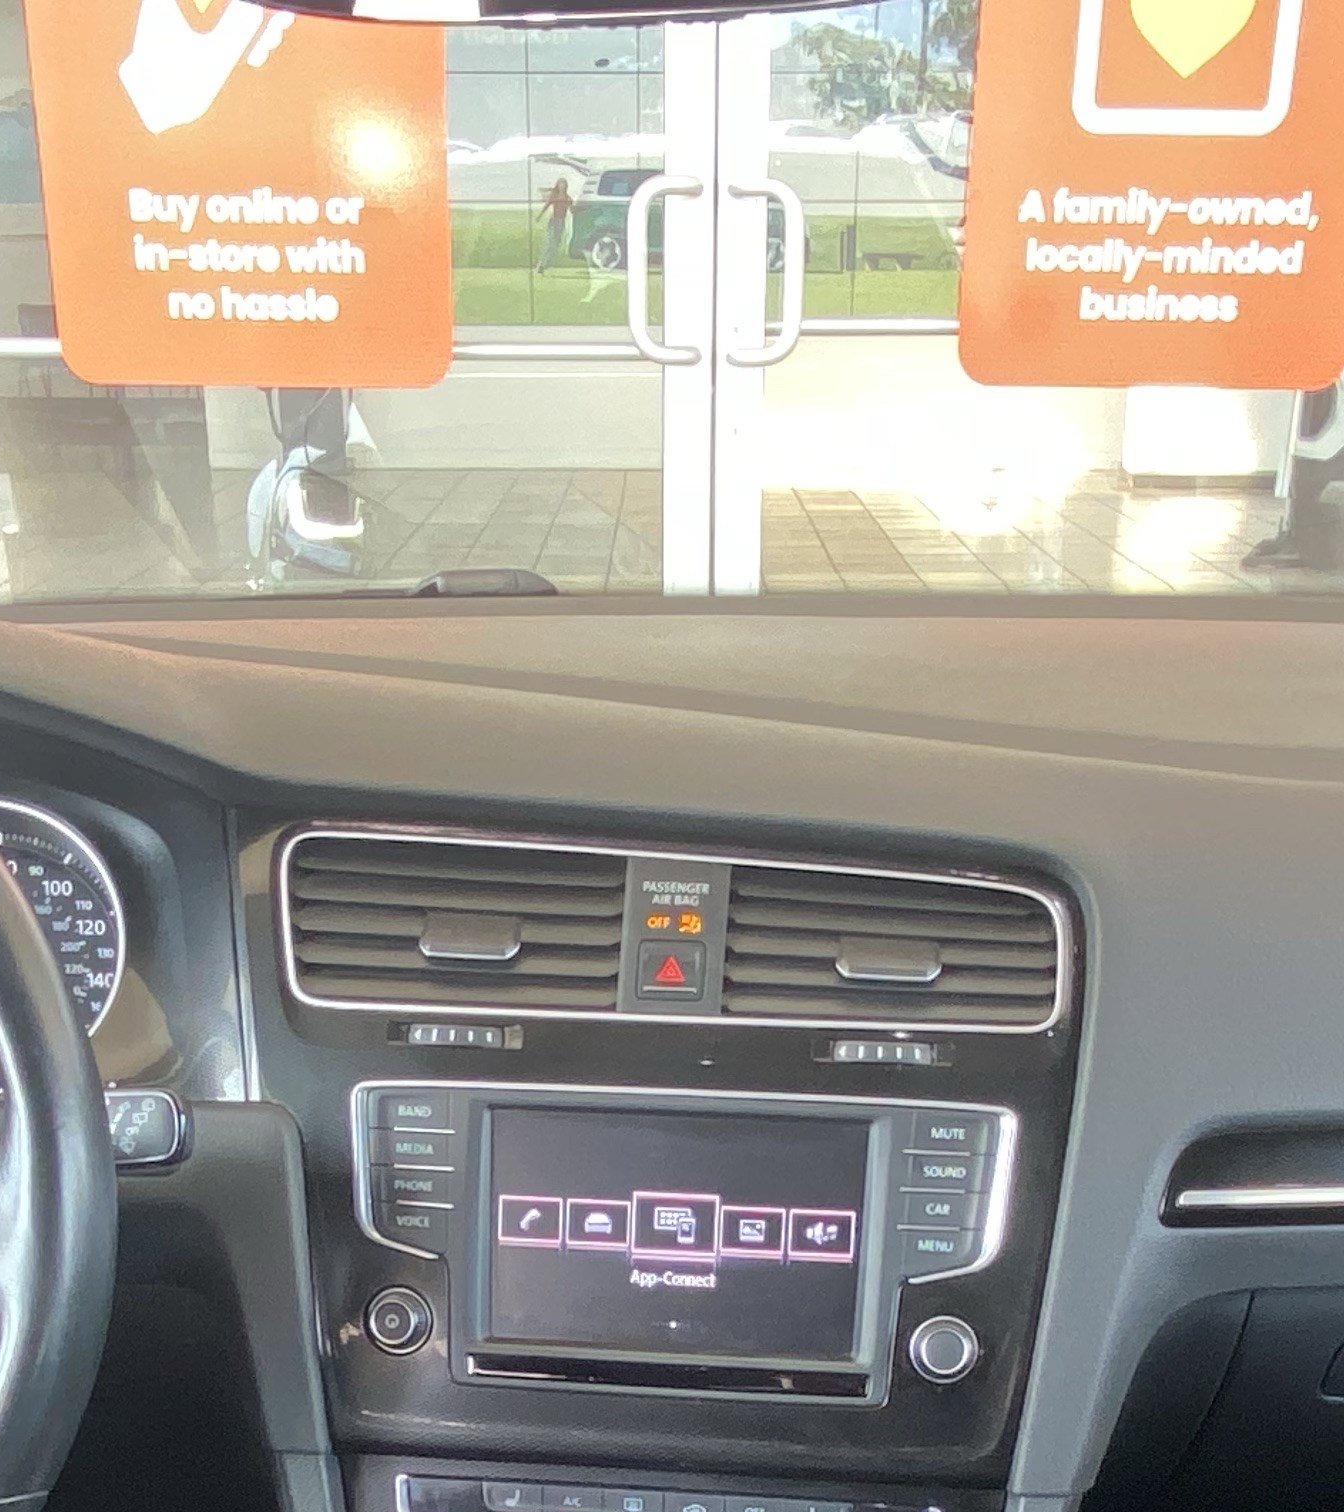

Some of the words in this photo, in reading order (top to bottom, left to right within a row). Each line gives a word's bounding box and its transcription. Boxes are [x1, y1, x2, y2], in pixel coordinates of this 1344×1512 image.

[129, 188, 197, 232] Buy
[206, 186, 318, 225] online
[324, 195, 365, 225] or
[1018, 189, 1045, 225] A
[1053, 187, 1320, 234] family-owned,
[134, 234, 279, 273] in-store
[284, 236, 366, 275] with
[1025, 236, 1304, 282] locally-minded
[168, 290, 215, 321] no
[221, 286, 340, 323] hassle
[1079, 286, 1239, 323] business
[41, 880, 73, 897] 100
[643, 881, 710, 895] PASSENGER
[74, 900, 93, 911] 110
[652, 894, 672, 905] AIR
[674, 895, 700, 906] BAG
[75, 920, 106, 936] 120
[647, 915, 670, 929] OFF
[930, 1127, 966, 1140] MUTE
[396, 1143, 434, 1155] MEDIA
[923, 1166, 966, 1179] SOUND
[394, 1180, 432, 1192] PHONE
[925, 1203, 951, 1215] CAR
[396, 1215, 430, 1228] VOICE
[917, 1240, 954, 1252] MENU
[629, 1269, 717, 1288] App-Connect
